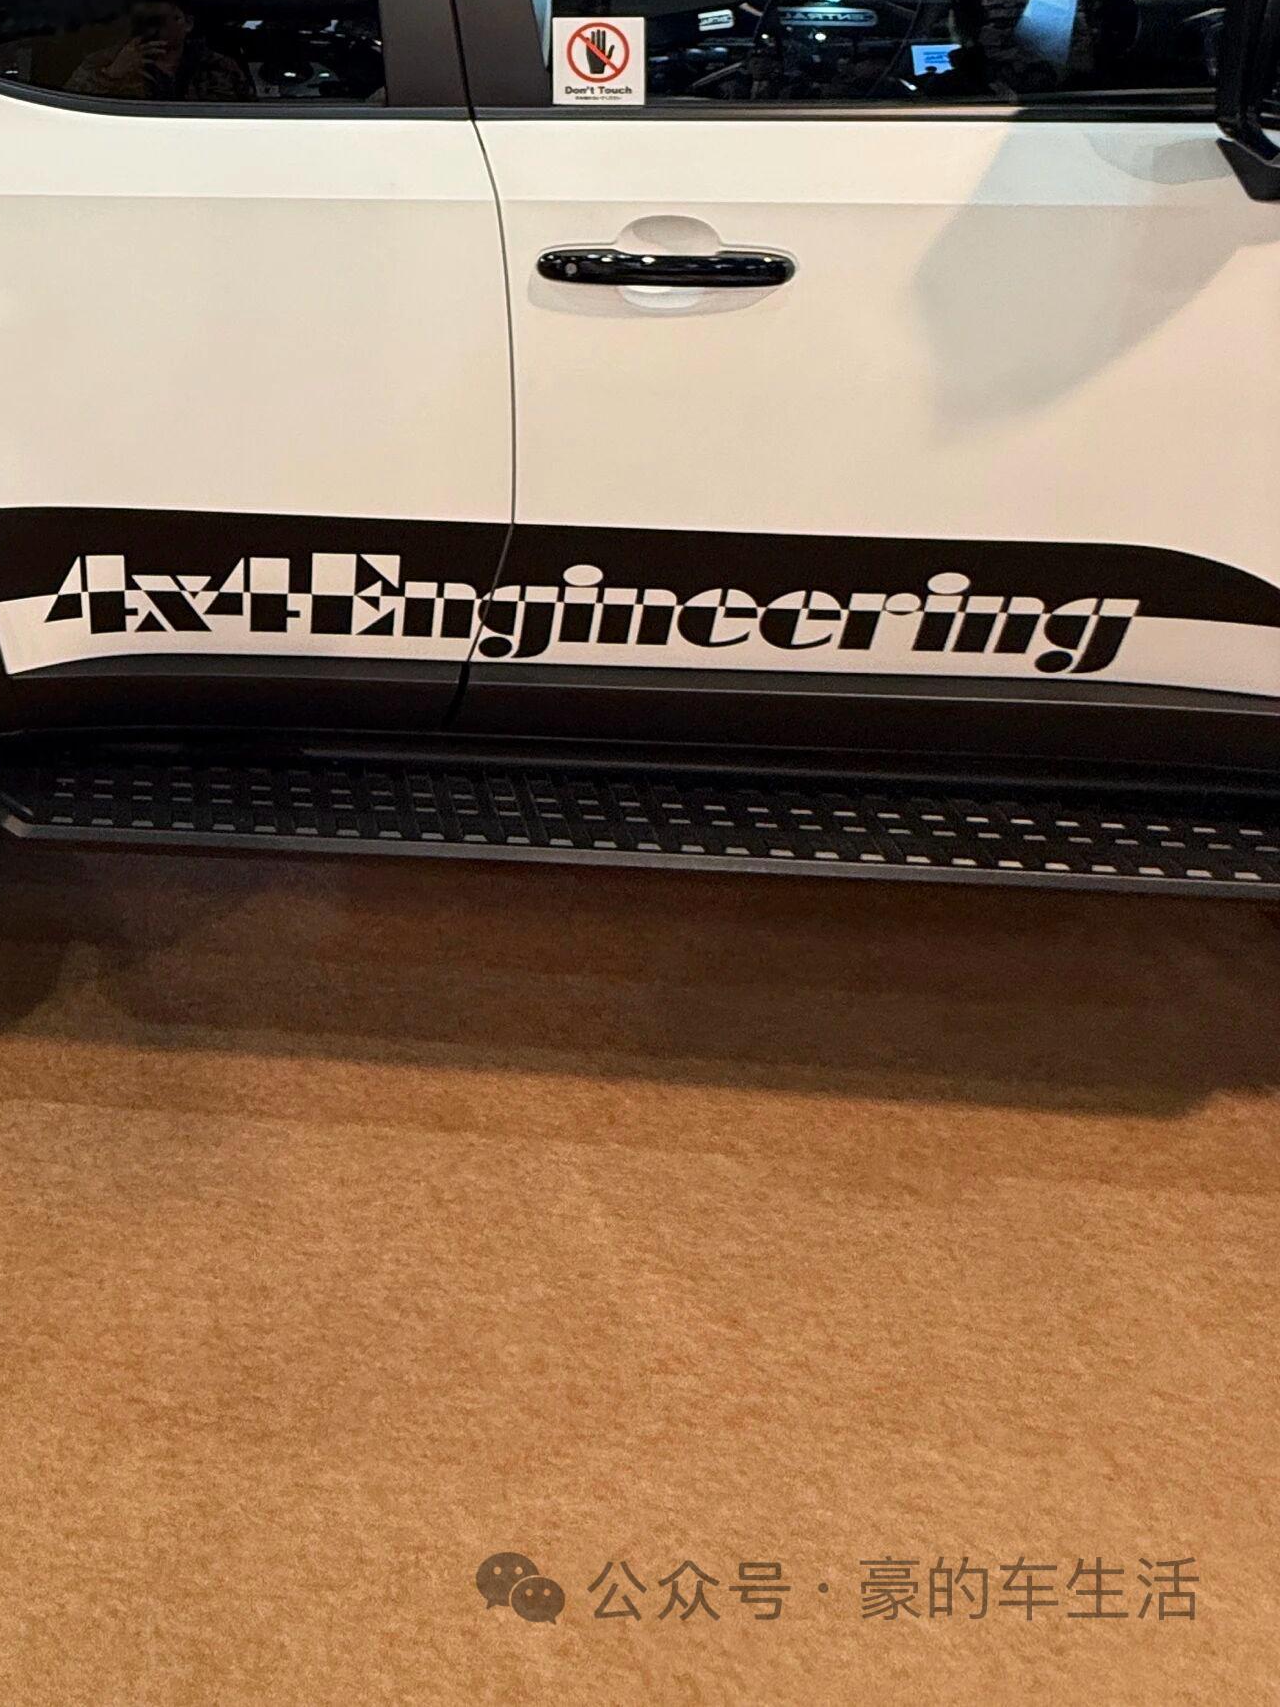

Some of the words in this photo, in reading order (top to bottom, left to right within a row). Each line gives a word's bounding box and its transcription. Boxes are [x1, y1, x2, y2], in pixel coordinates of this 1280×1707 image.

[565, 86, 595, 94] Don't
[597, 86, 632, 94] Touch
[44, 552, 1141, 675] 4x4Engineering
